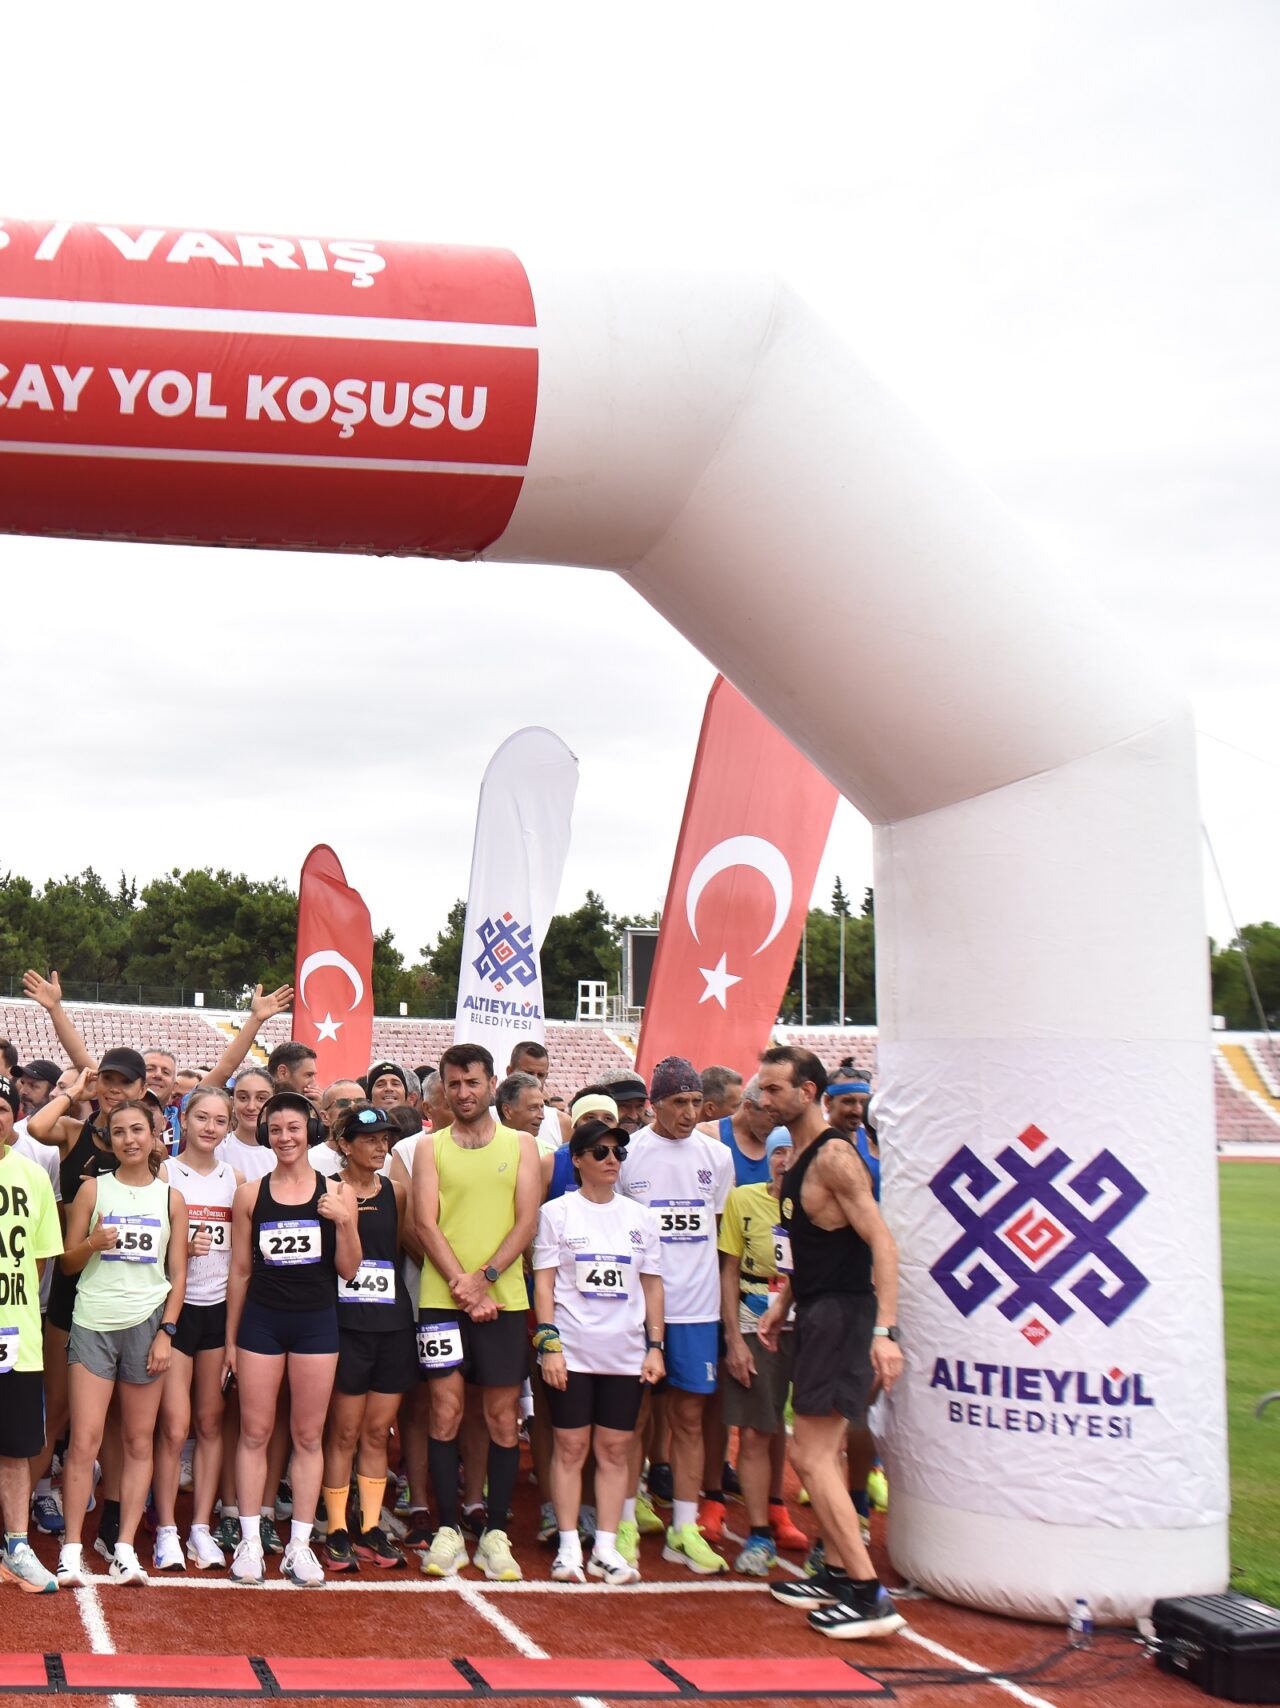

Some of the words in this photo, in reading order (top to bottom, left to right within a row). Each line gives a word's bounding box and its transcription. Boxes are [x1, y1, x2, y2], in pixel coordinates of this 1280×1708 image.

[34, 221, 73, 261] /
[96, 226, 386, 288] VARIŞ
[108, 367, 227, 419] YOL
[245, 374, 488, 439] KOŞUSU
[661, 1214, 701, 1231] 355
[269, 1236, 312, 1254] 223
[586, 1269, 624, 1287] 481
[419, 1339, 453, 1357] 265
